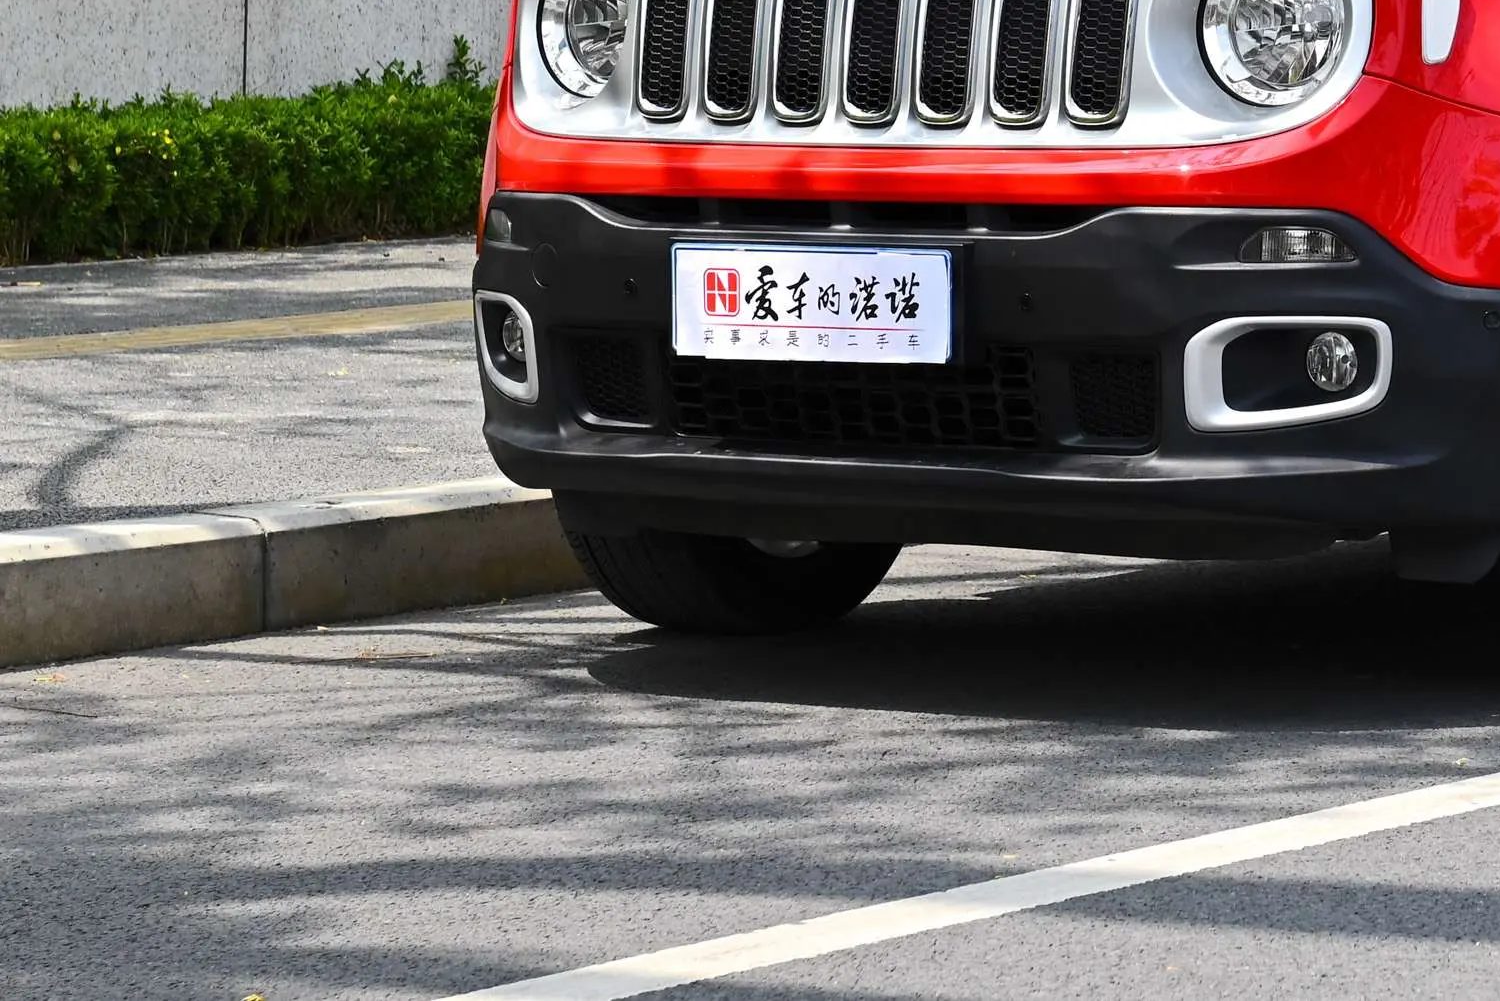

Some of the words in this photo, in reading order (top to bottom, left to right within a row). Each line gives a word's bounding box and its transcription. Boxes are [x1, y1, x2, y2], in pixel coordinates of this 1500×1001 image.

[703, 327, 921, 350] 实事求是的二手车
